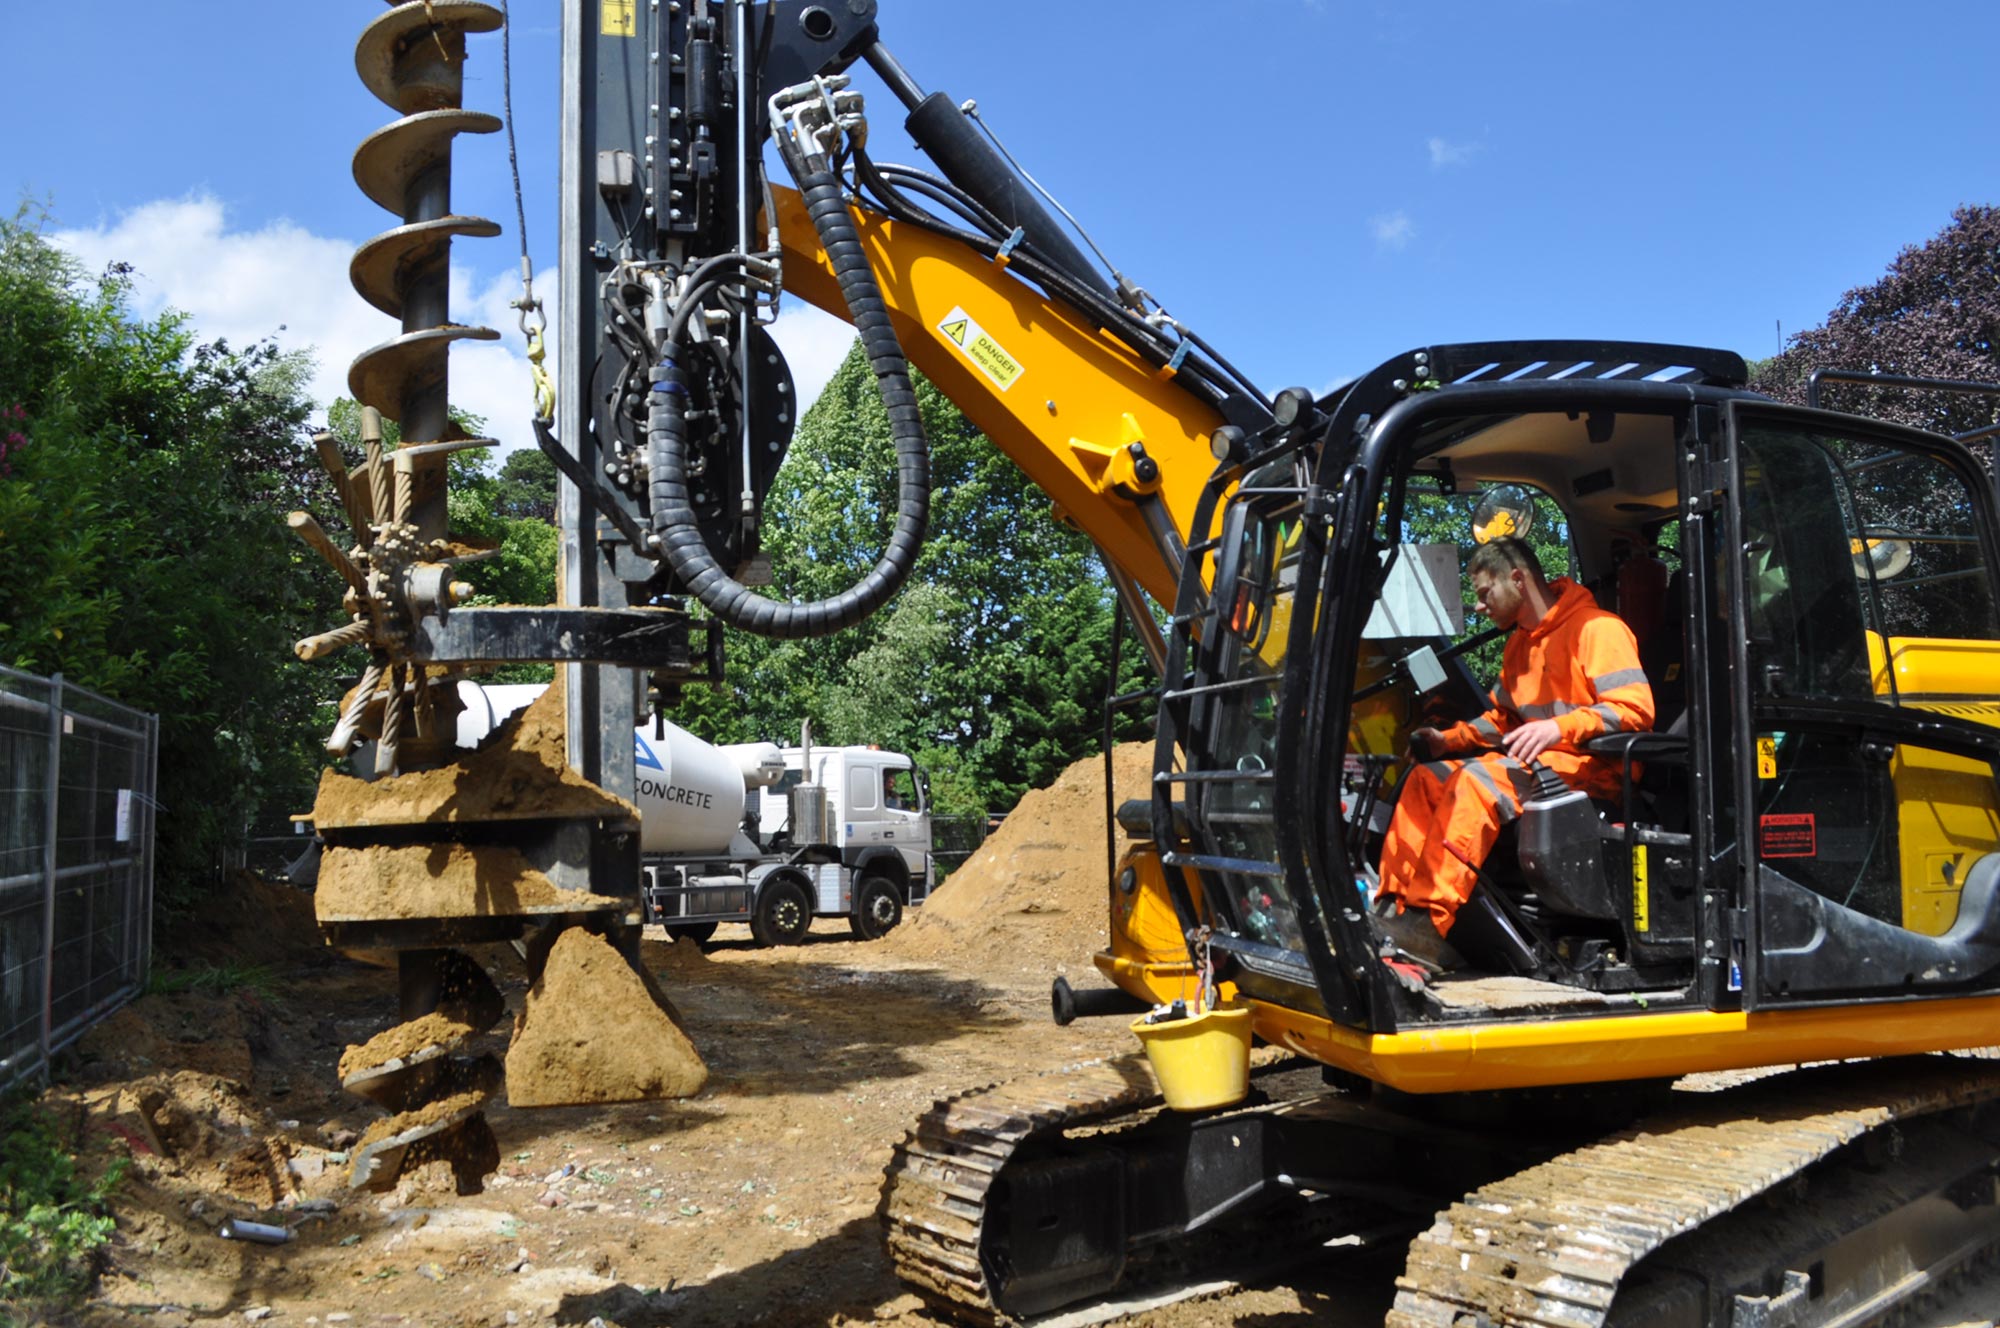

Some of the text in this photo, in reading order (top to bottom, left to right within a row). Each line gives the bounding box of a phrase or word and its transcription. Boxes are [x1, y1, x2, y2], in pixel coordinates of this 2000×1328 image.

[970, 346, 1007, 382] keep clear
[978, 338, 1016, 374] DANGER
